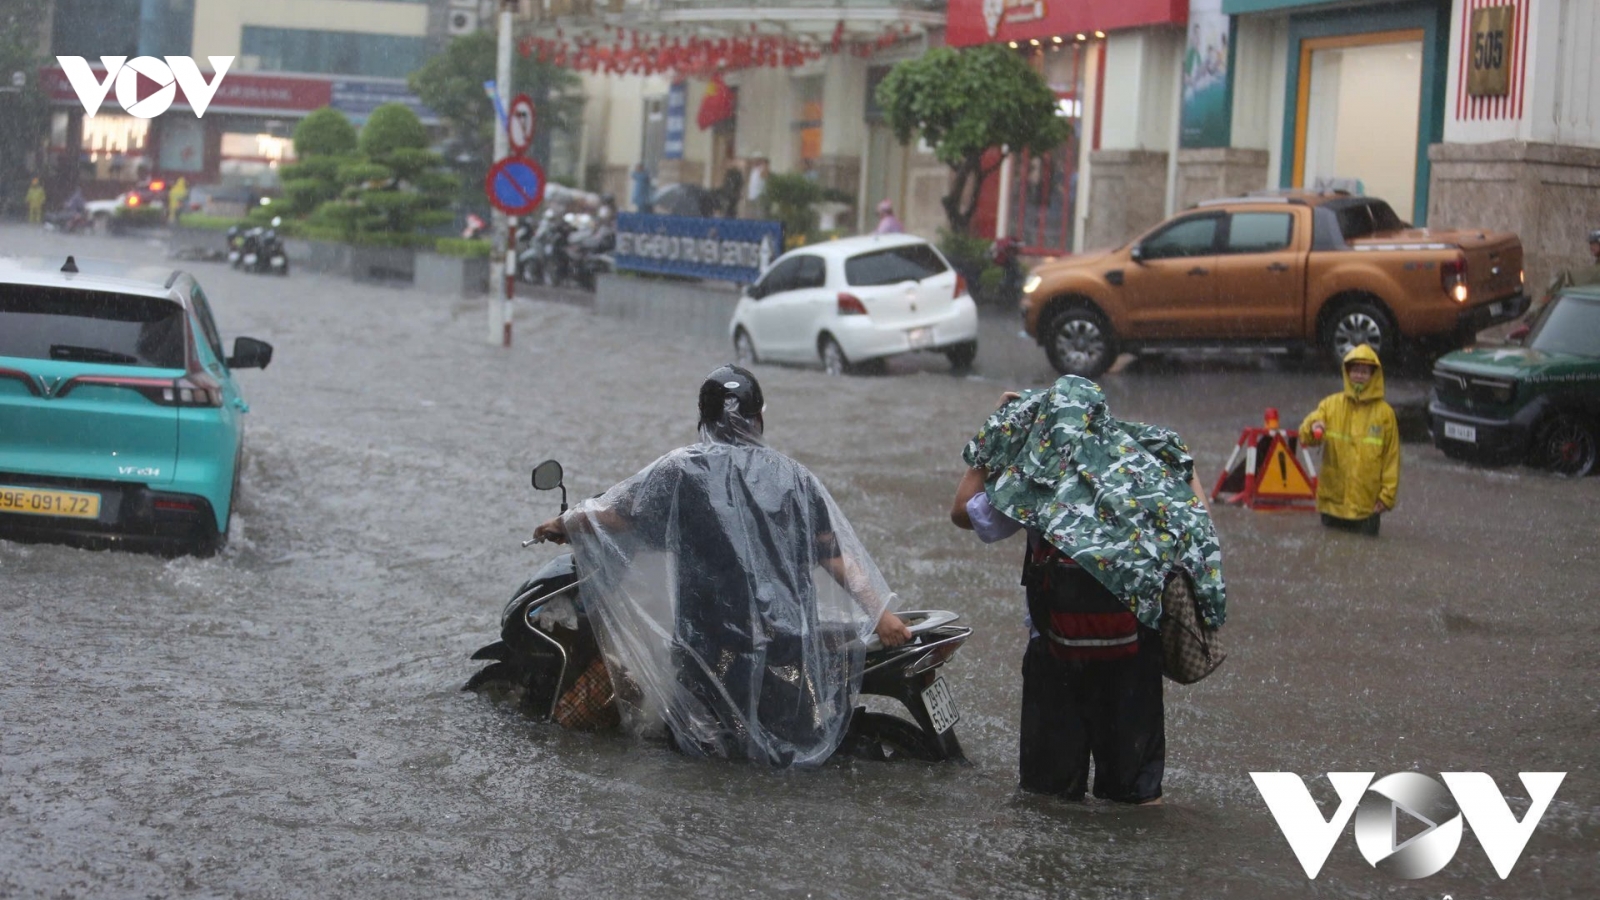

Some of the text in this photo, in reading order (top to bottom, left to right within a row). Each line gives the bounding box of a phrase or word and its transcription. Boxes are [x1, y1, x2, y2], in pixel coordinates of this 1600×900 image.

[1474, 30, 1503, 70] 505
[118, 466, 134, 475] VF
[925, 681, 947, 710] 29-F1
